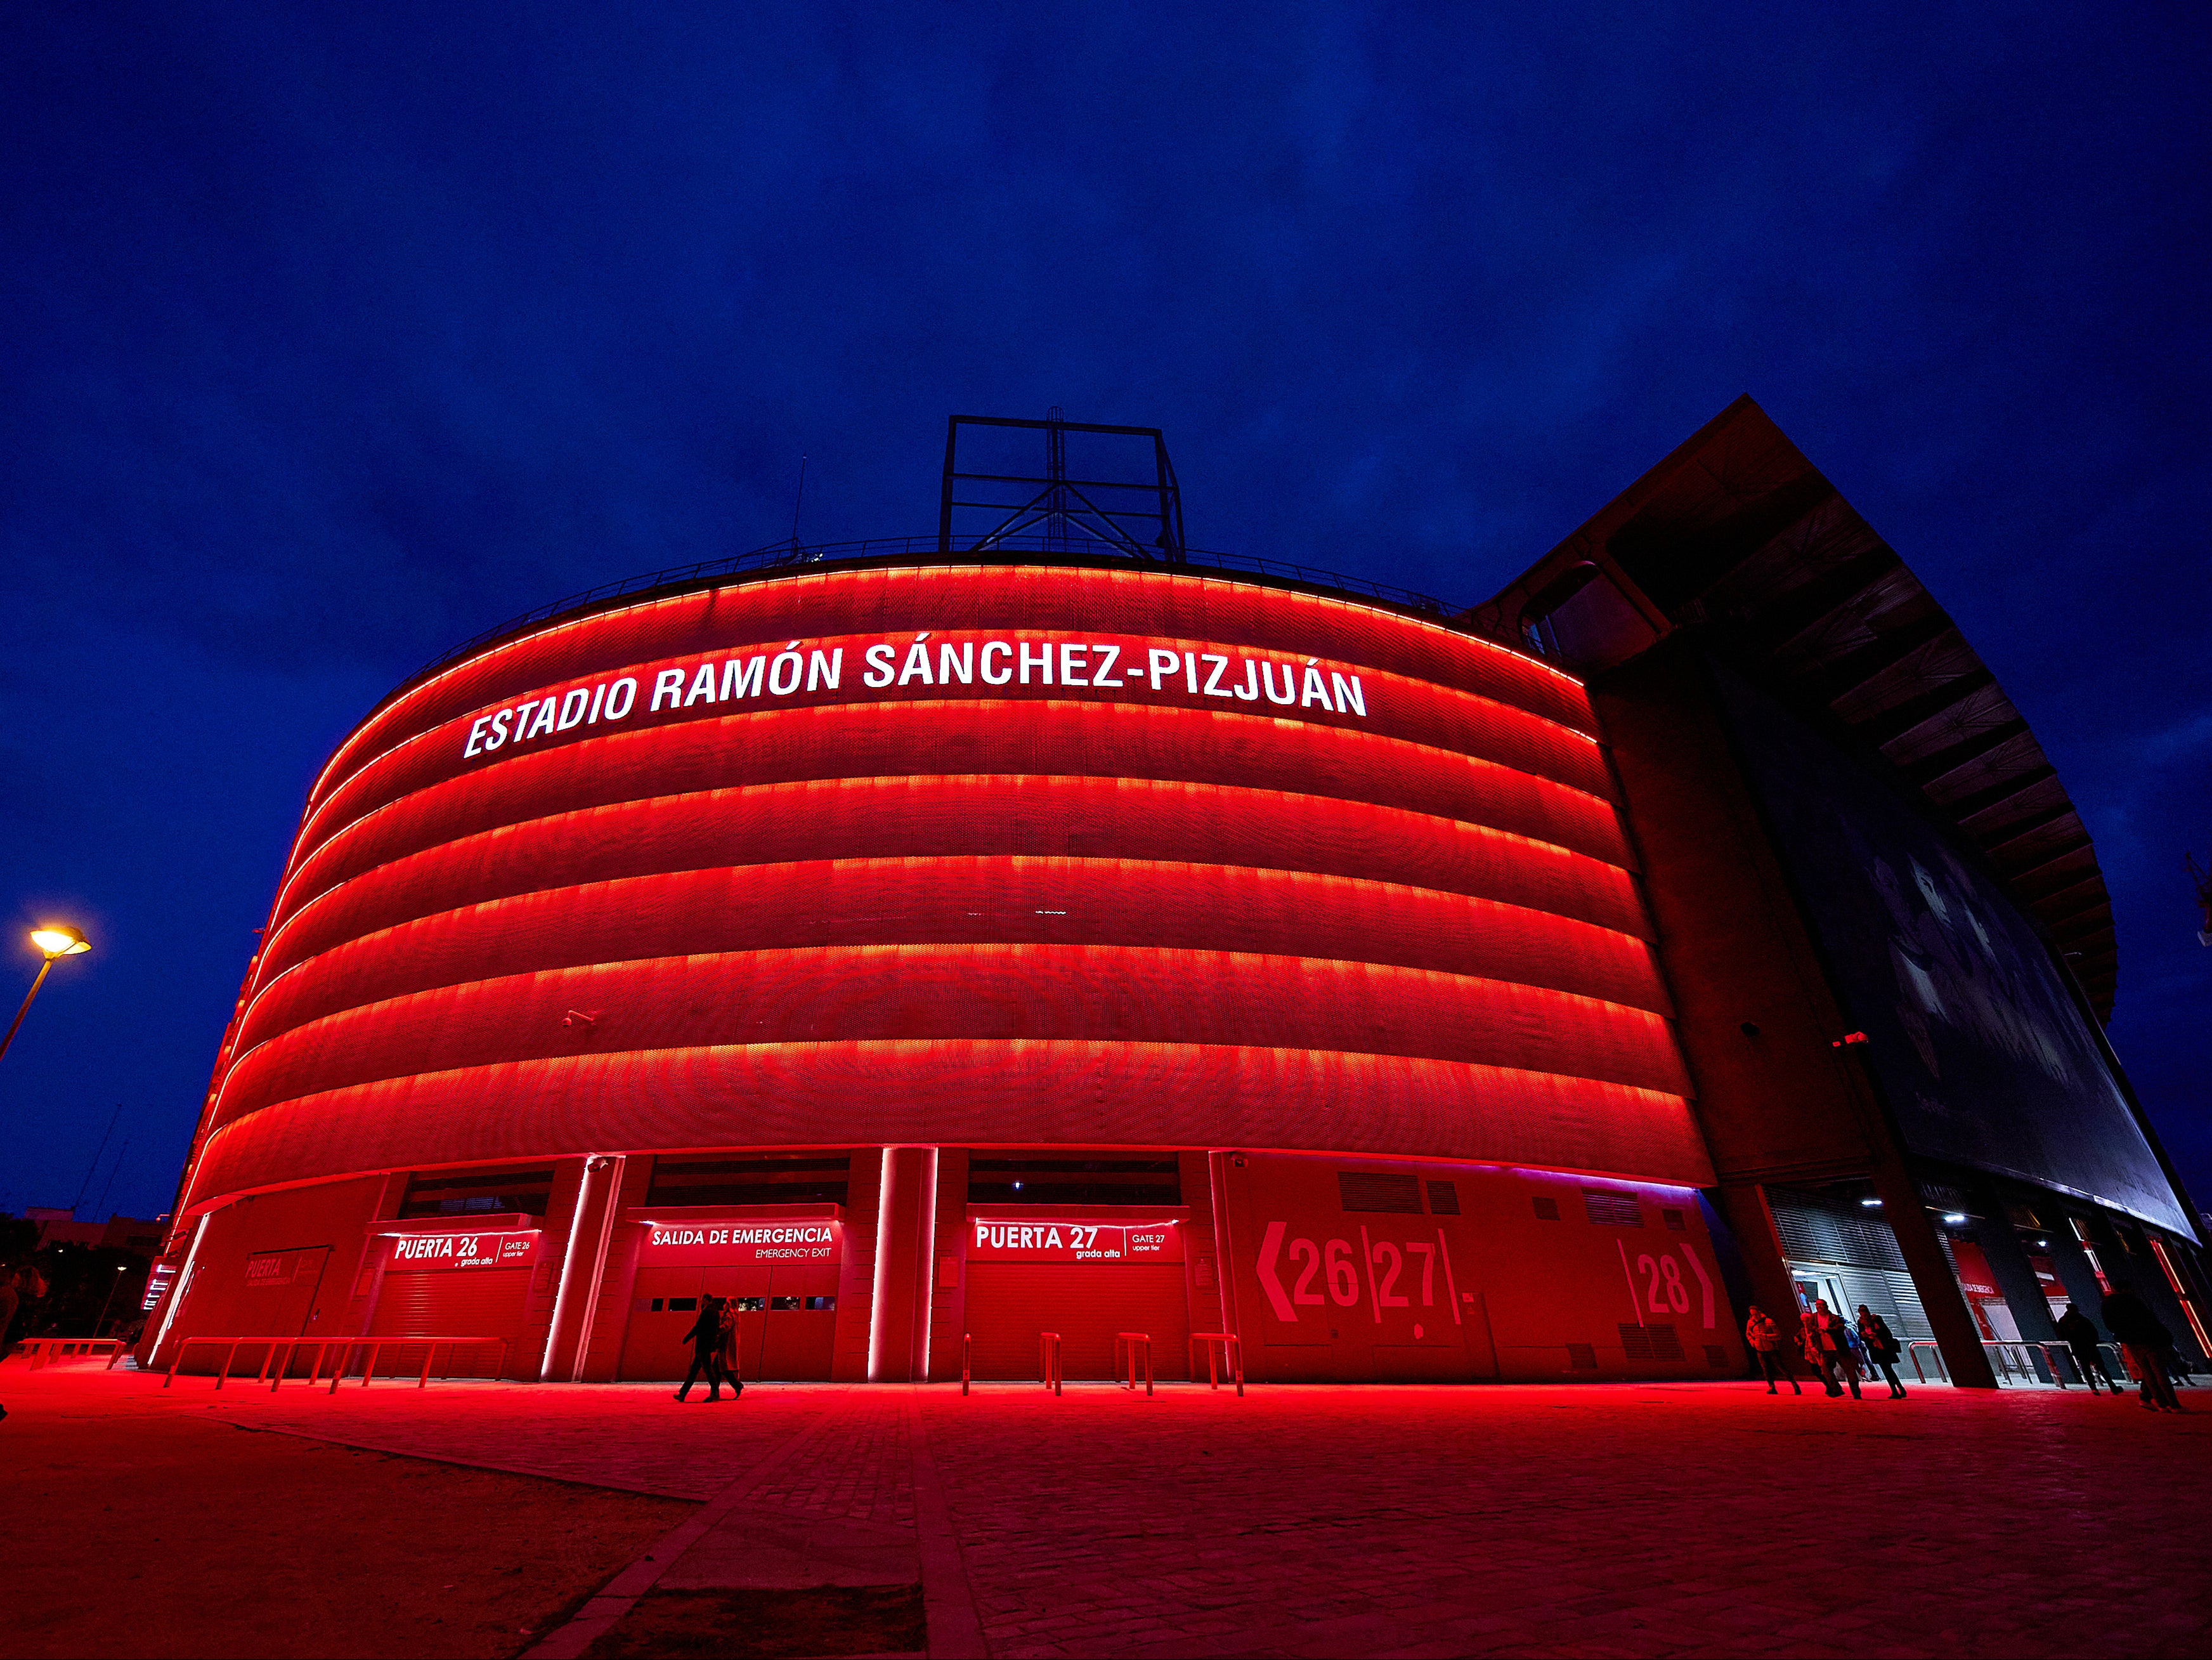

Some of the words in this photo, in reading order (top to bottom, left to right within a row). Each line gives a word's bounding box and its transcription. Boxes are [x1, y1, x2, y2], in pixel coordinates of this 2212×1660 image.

[463, 677, 637, 759] ESTADIO
[650, 641, 843, 712] RAMÓN
[863, 632, 1367, 717] SÁNCHEZ-PIZJUÁN
[505, 1241, 521, 1250] GATE
[521, 1241, 530, 1250] 26
[652, 1229, 705, 1246] SALIDA
[709, 1229, 729, 1245] DE
[732, 1227, 833, 1245] EMERGENCIA
[977, 1227, 1063, 1248] PUERTA
[1070, 1227, 1098, 1249] 27
[1132, 1234, 1154, 1243] GATE
[1155, 1234, 1165, 1243] 27
[394, 1237, 452, 1259] PUERTA
[456, 1236, 478, 1257] 26
[755, 1248, 810, 1258] EMERGENCY
[812, 1247, 832, 1258] EXIT
[1076, 1249, 1102, 1260] grada
[1103, 1249, 1121, 1258] alta
[245, 1257, 281, 1278] PUERTA
[460, 1255, 479, 1267] grada
[480, 1257, 493, 1265] alta
[1289, 1238, 1359, 1307] 26
[1372, 1241, 1435, 1307] 27
[1637, 1254, 1689, 1314] 28
